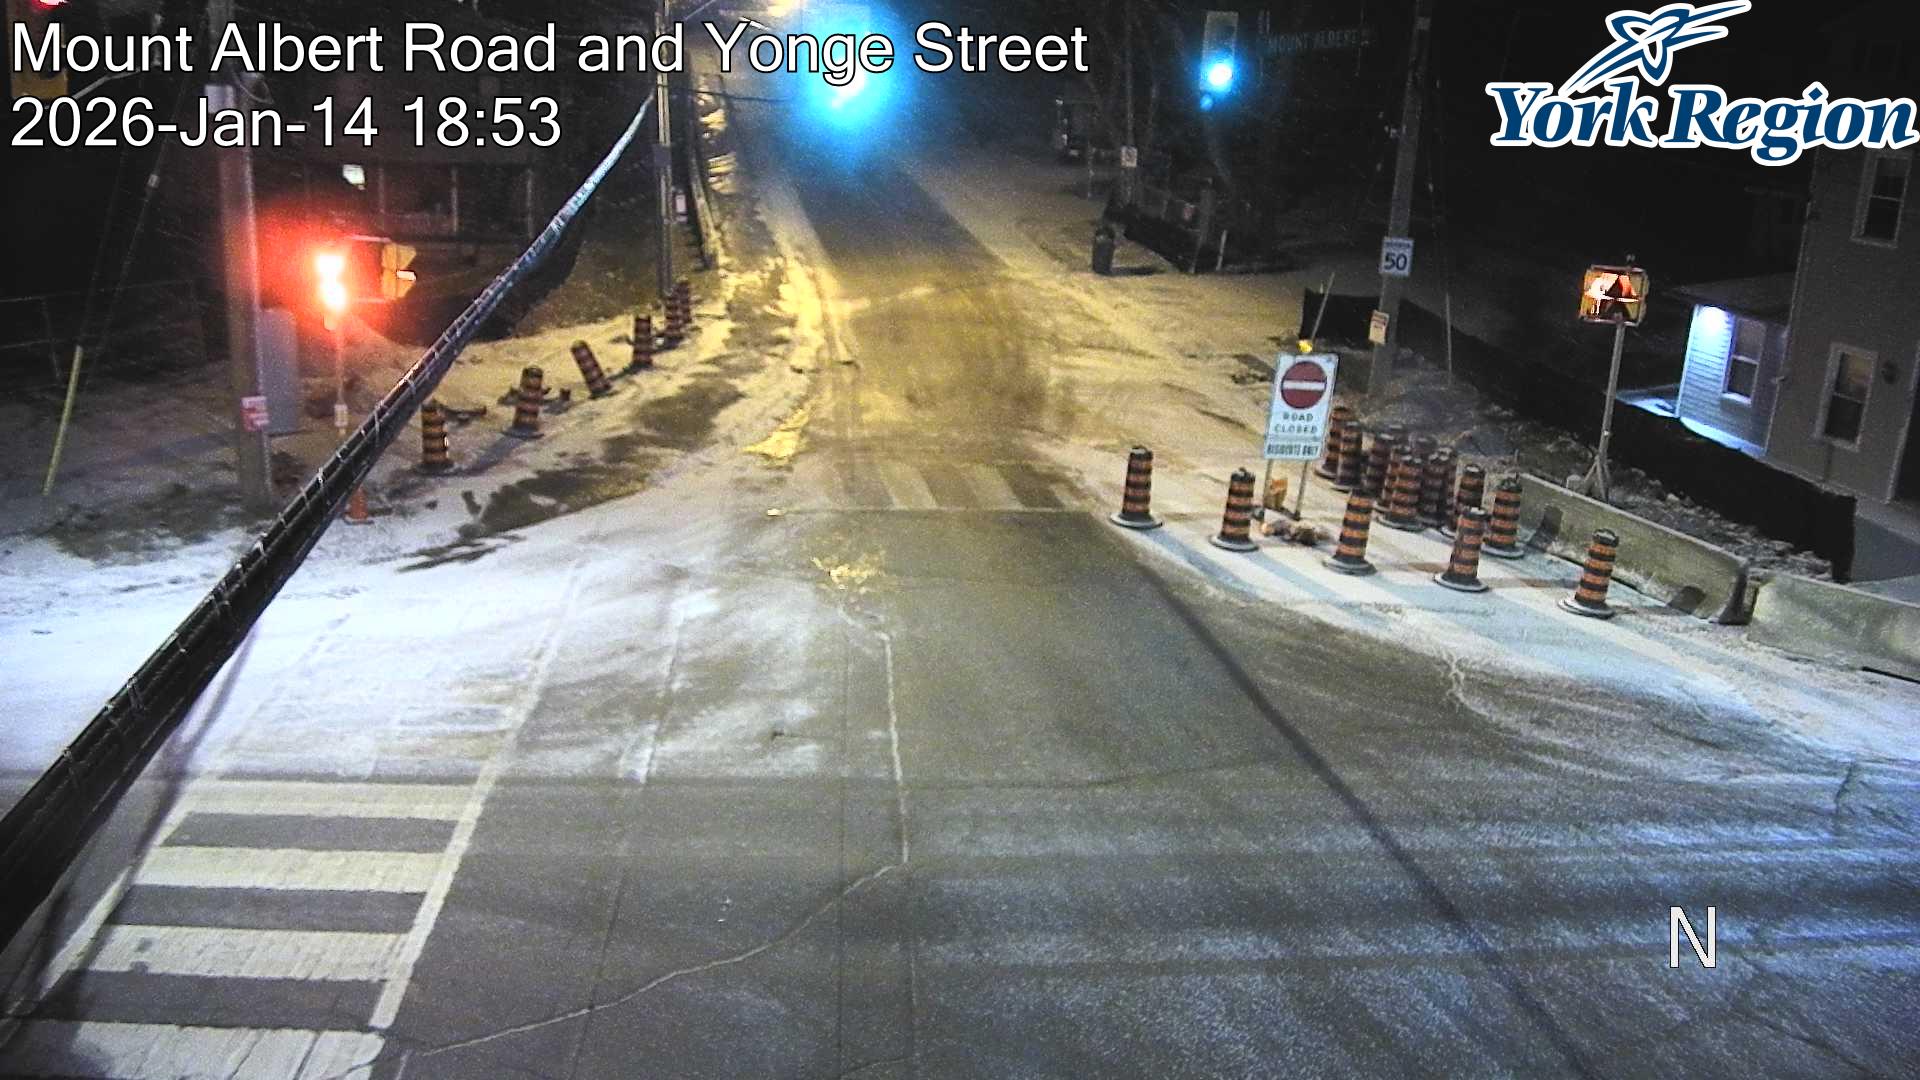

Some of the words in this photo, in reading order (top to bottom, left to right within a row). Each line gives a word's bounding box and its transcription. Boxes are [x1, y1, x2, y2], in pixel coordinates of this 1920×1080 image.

[1384, 251, 1408, 271] 50
[1282, 411, 1314, 423] ROAD
[1274, 423, 1318, 434] CLOSED
